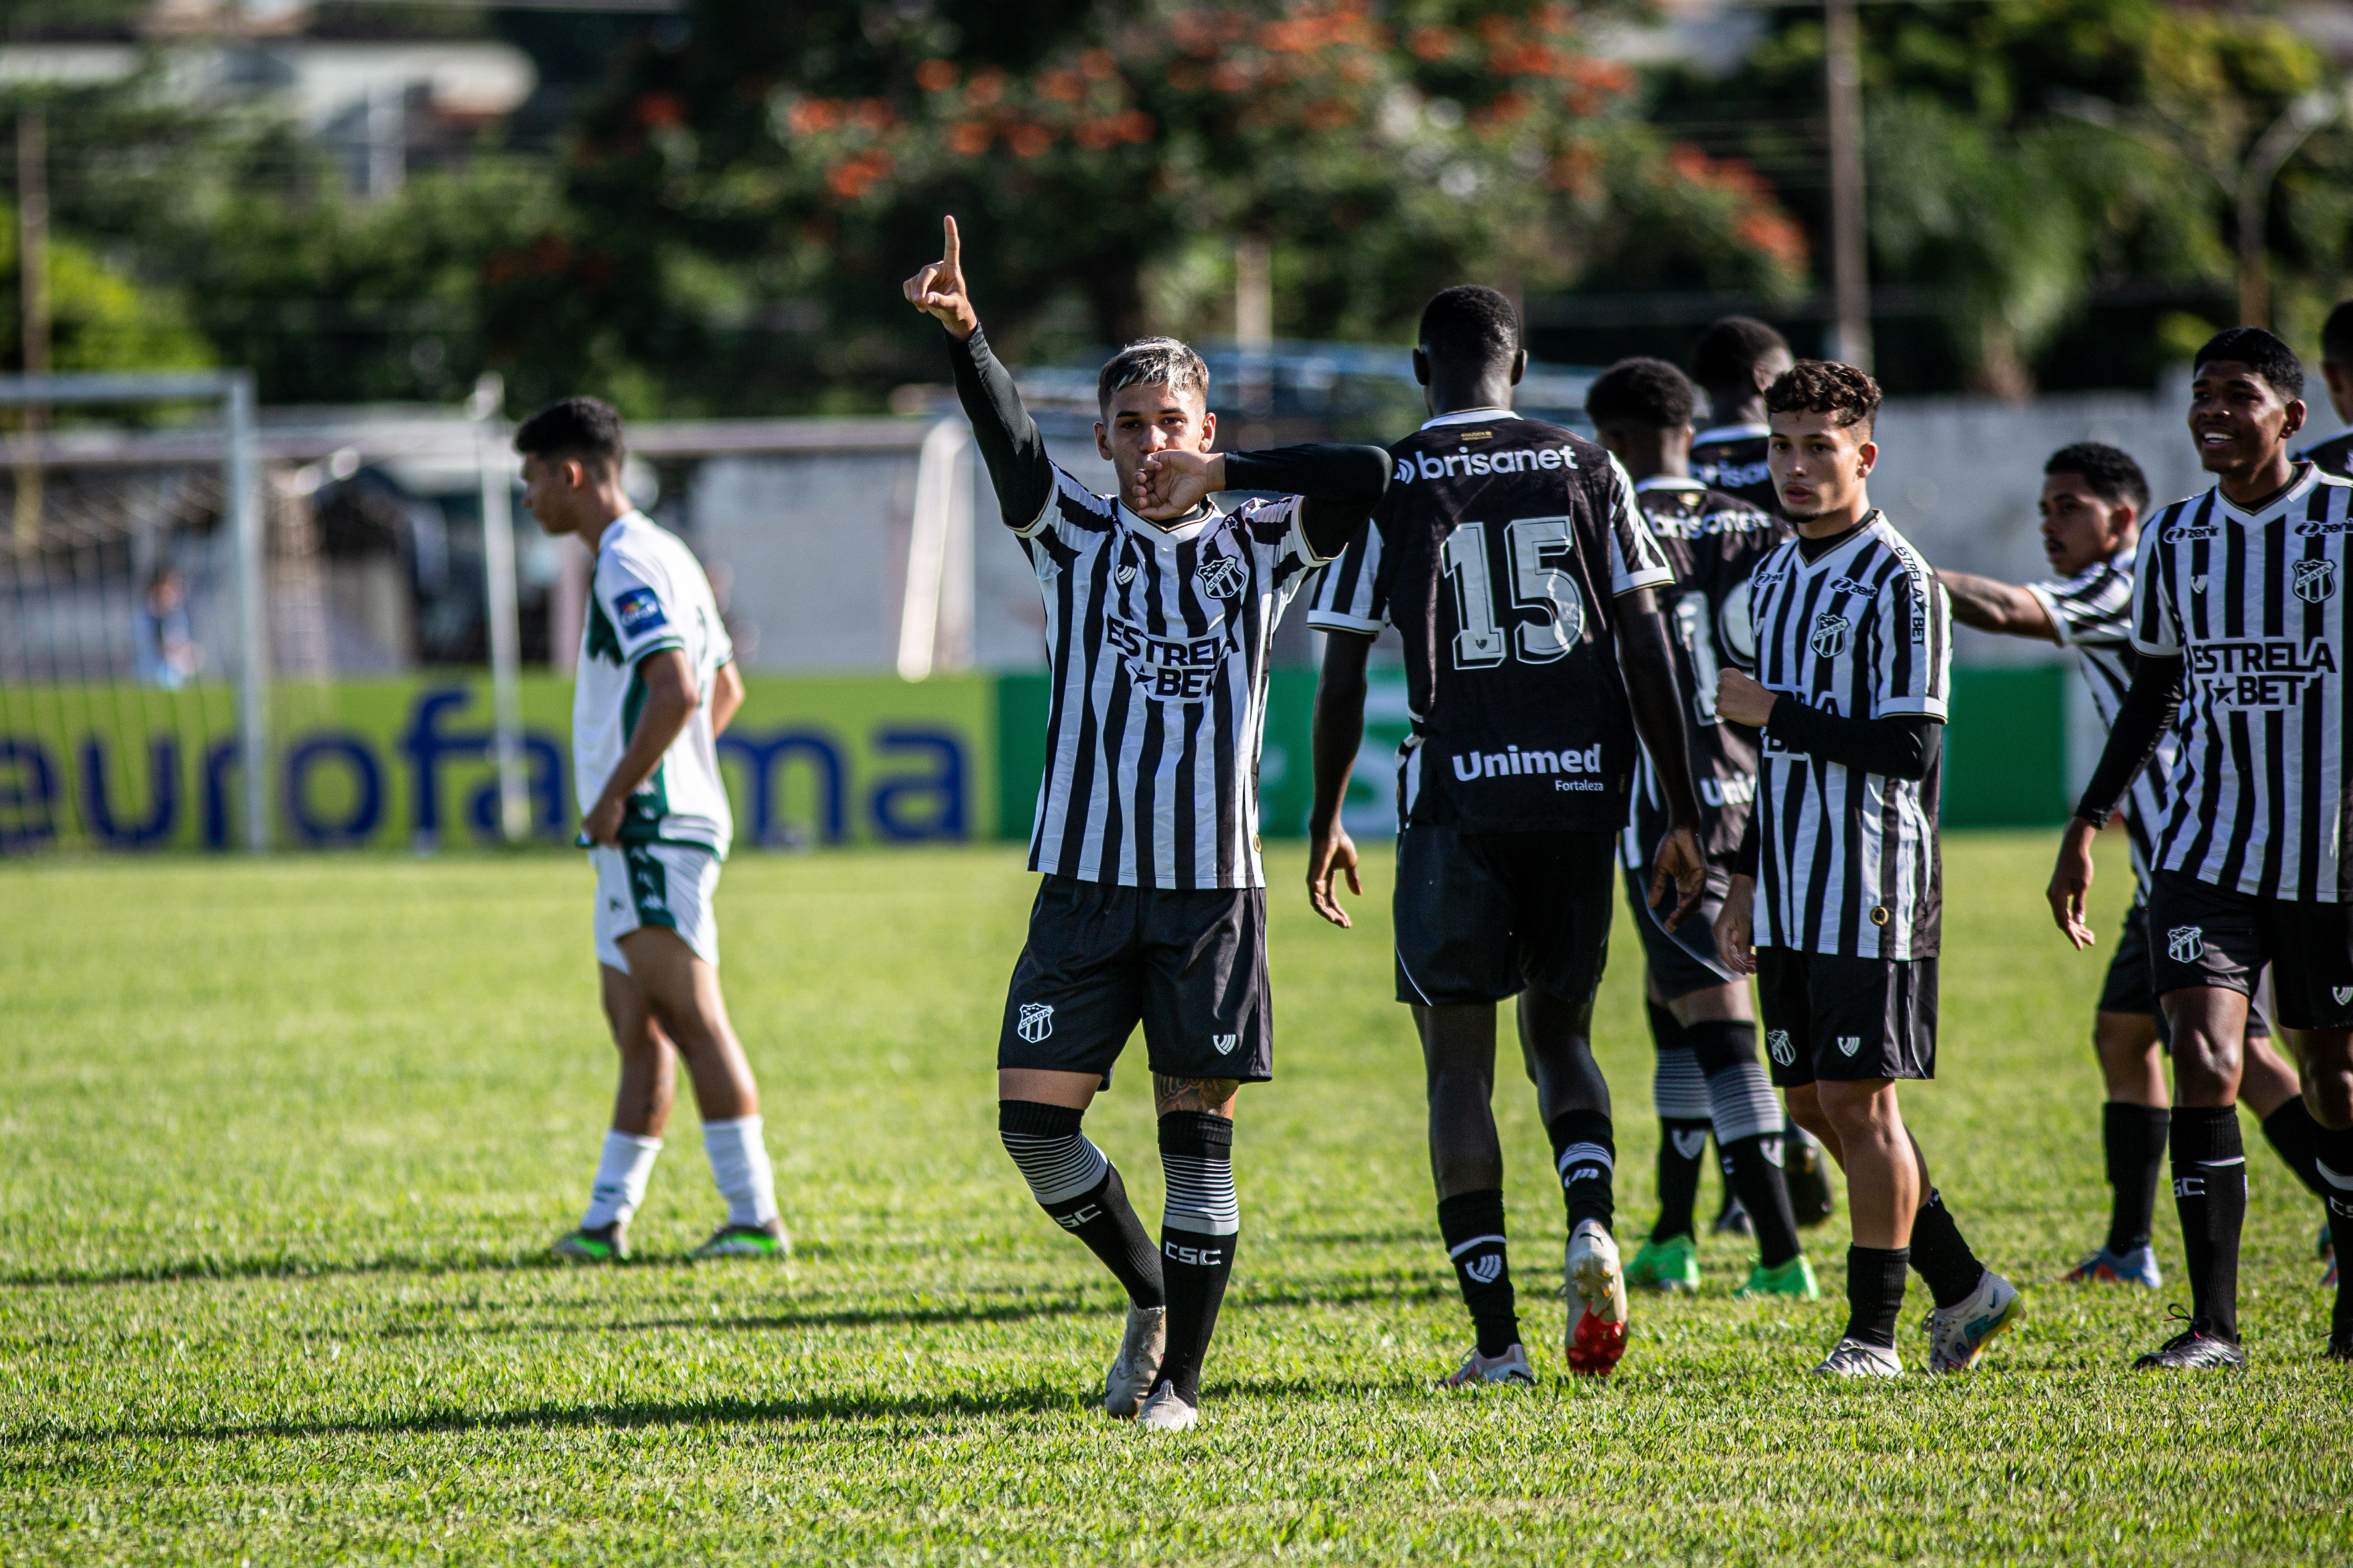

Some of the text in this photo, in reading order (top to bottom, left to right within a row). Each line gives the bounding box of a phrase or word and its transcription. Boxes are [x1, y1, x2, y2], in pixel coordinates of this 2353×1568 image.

[1415, 445, 1579, 480] brisanet
[1643, 506, 1773, 540] brisanet
[2322, 519, 2353, 533] zeni
[1894, 546, 1925, 600] ESTRELA
[1440, 515, 1586, 670] 15
[1106, 613, 1241, 667] ESTRELA
[2191, 643, 2338, 673] ESTRELA
[1155, 667, 1214, 698] BET
[2237, 675, 2306, 706] BET
[0, 690, 967, 849] eurofama
[1452, 743, 1602, 782] Unimed
[1555, 779, 1604, 791] Fortaleza
[1055, 1203, 1102, 1228] SC
[1165, 1241, 1222, 1266] CSC
